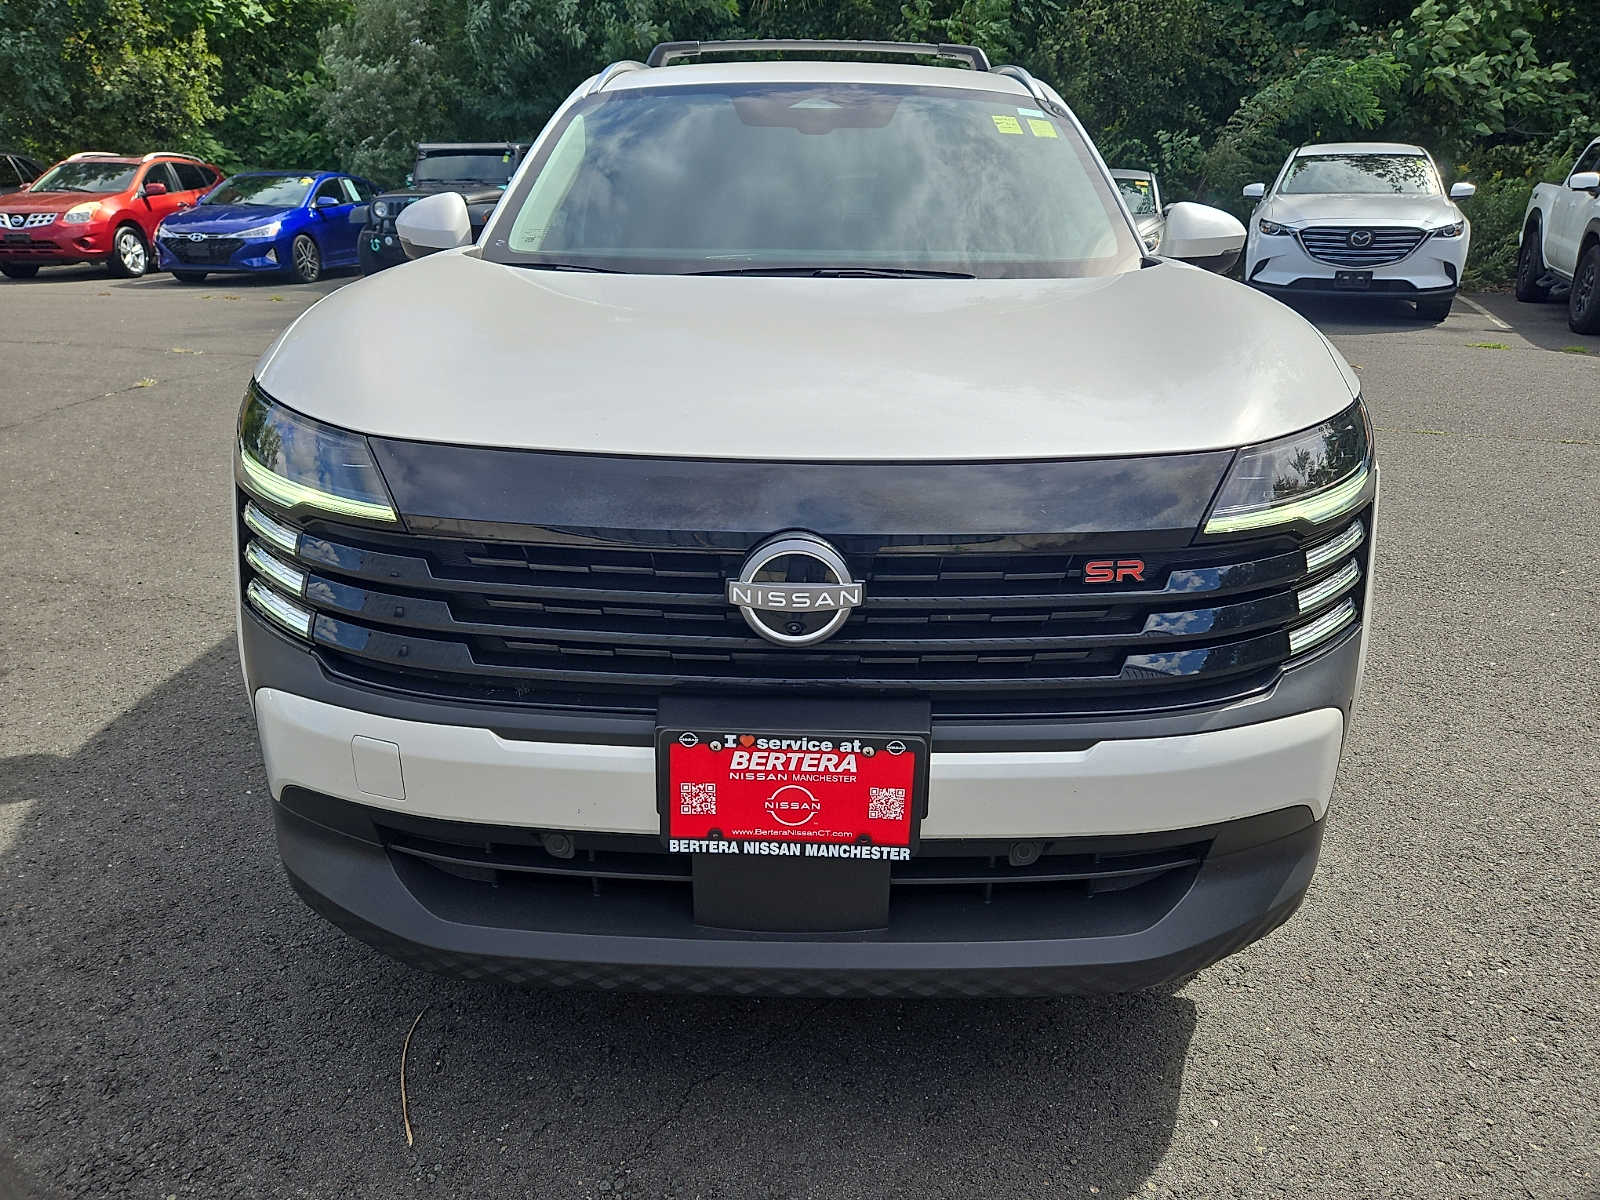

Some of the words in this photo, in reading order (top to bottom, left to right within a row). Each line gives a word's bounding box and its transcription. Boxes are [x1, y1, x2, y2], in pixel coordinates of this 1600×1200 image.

[1085, 560, 1145, 583] SR
[732, 587, 859, 607] NISSAN
[724, 734, 737, 748] I
[756, 737, 833, 751] service
[839, 739, 861, 752] at
[729, 750, 858, 773] BERTERA
[729, 772, 788, 781] NISSAN
[792, 774, 857, 783] MANCHESTER
[764, 801, 820, 810] NISSAN
[731, 828, 853, 838] www.BerteraNissanCT.com
[669, 839, 739, 854] BERTERA
[743, 841, 801, 856] NISSAN
[805, 844, 911, 860] MANCHESTER
